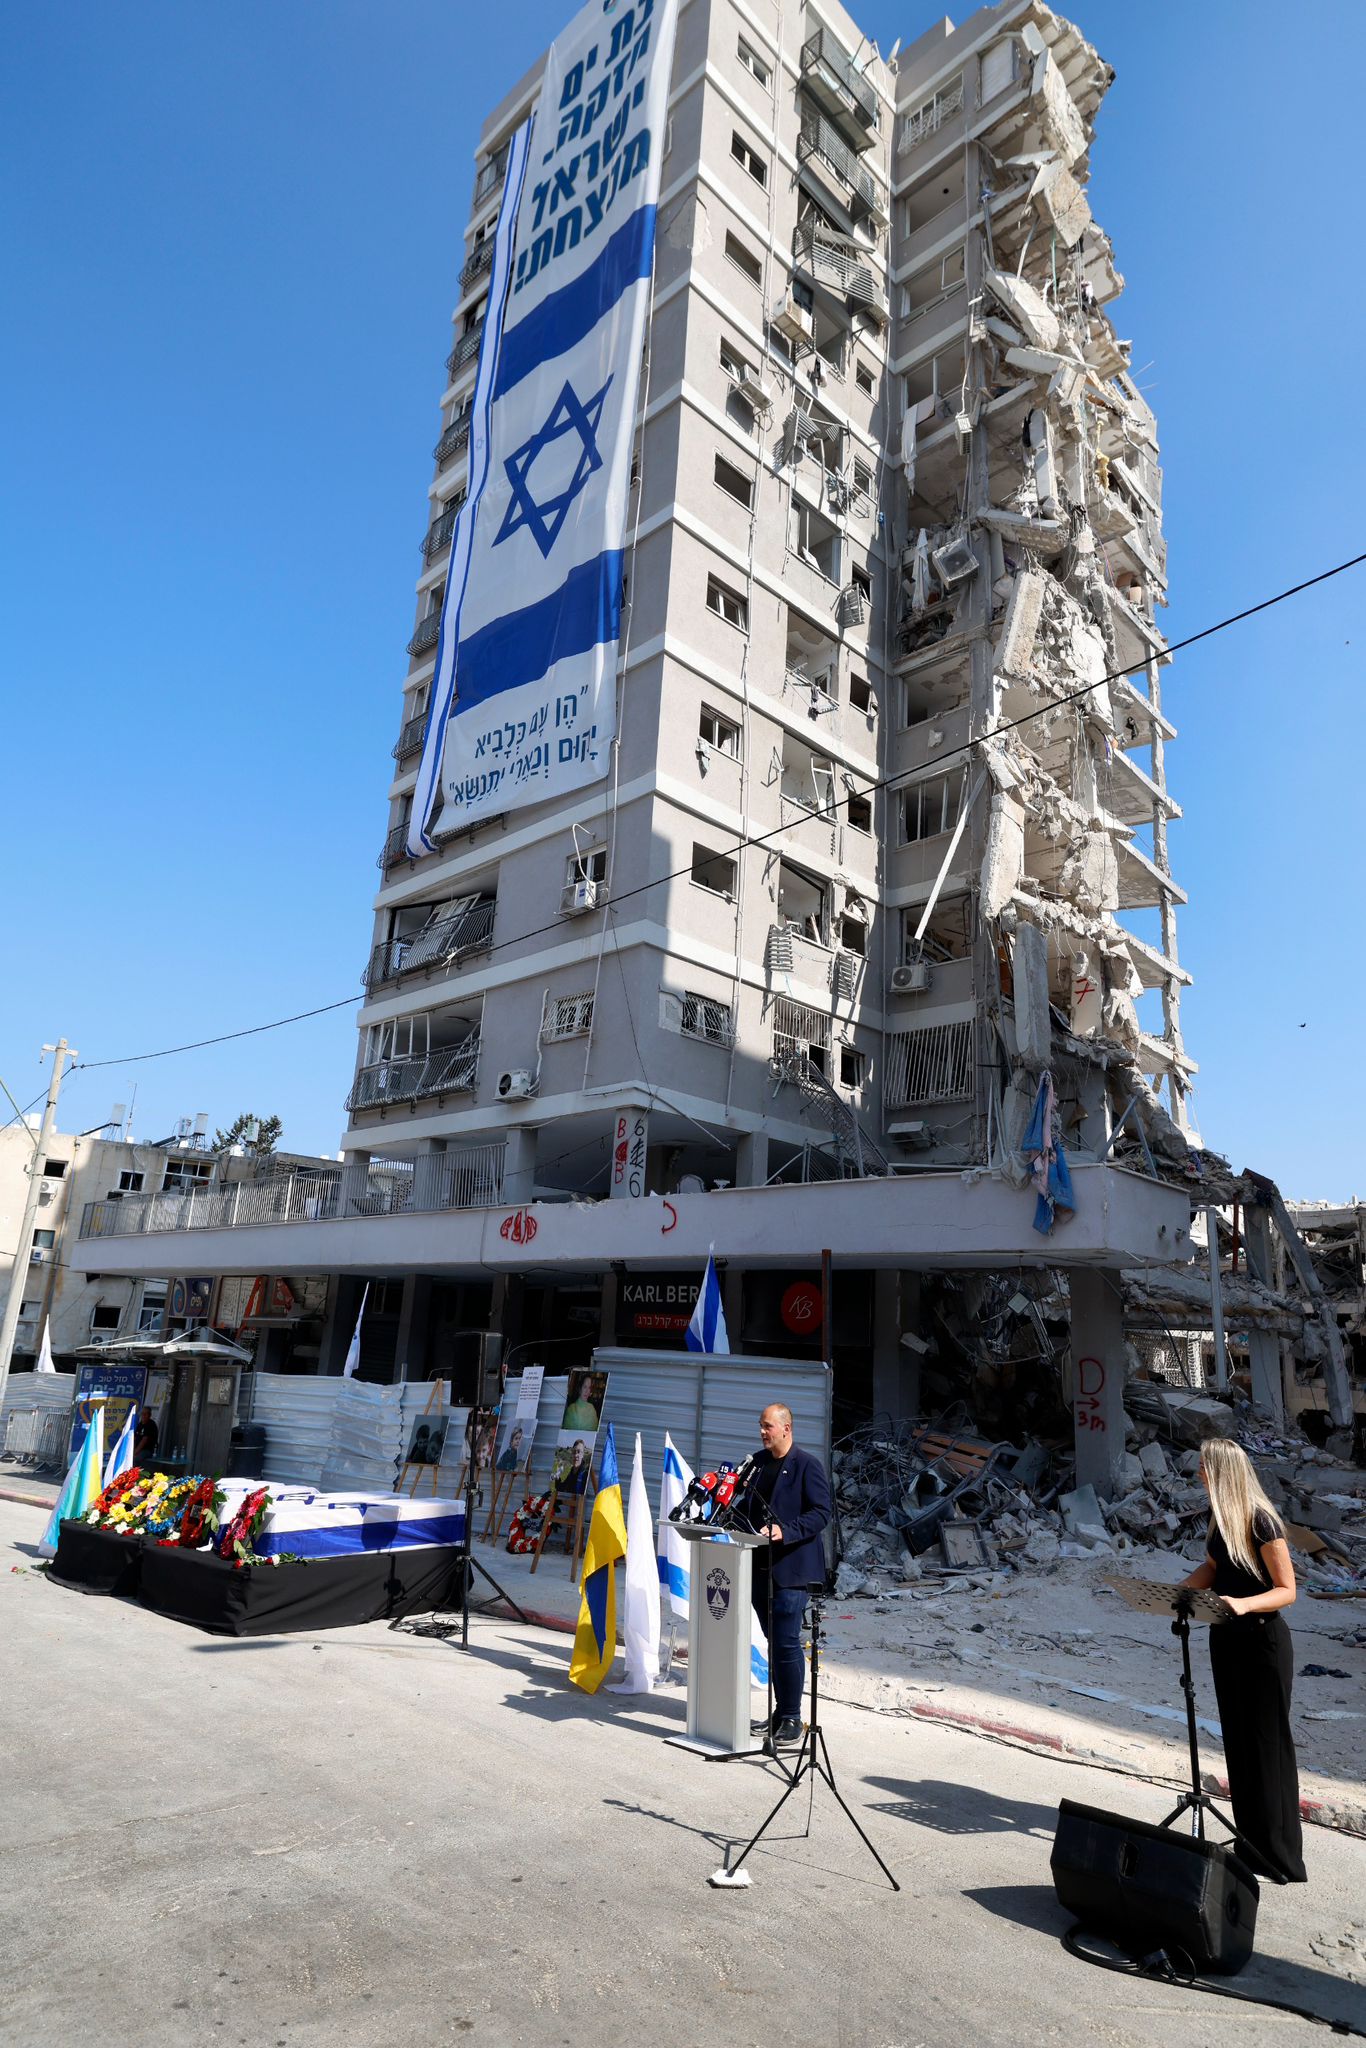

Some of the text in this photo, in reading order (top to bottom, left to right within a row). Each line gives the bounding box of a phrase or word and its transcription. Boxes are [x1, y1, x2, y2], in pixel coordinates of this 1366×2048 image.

[559, 0, 654, 111] בת ים
[531, 77, 646, 232] ישראל
[514, 128, 651, 295] מנצחת!
[623, 1285, 699, 1303] KARL BER
[1079, 1358, 1105, 1396] D
[720, 1465, 729, 1474] 15
